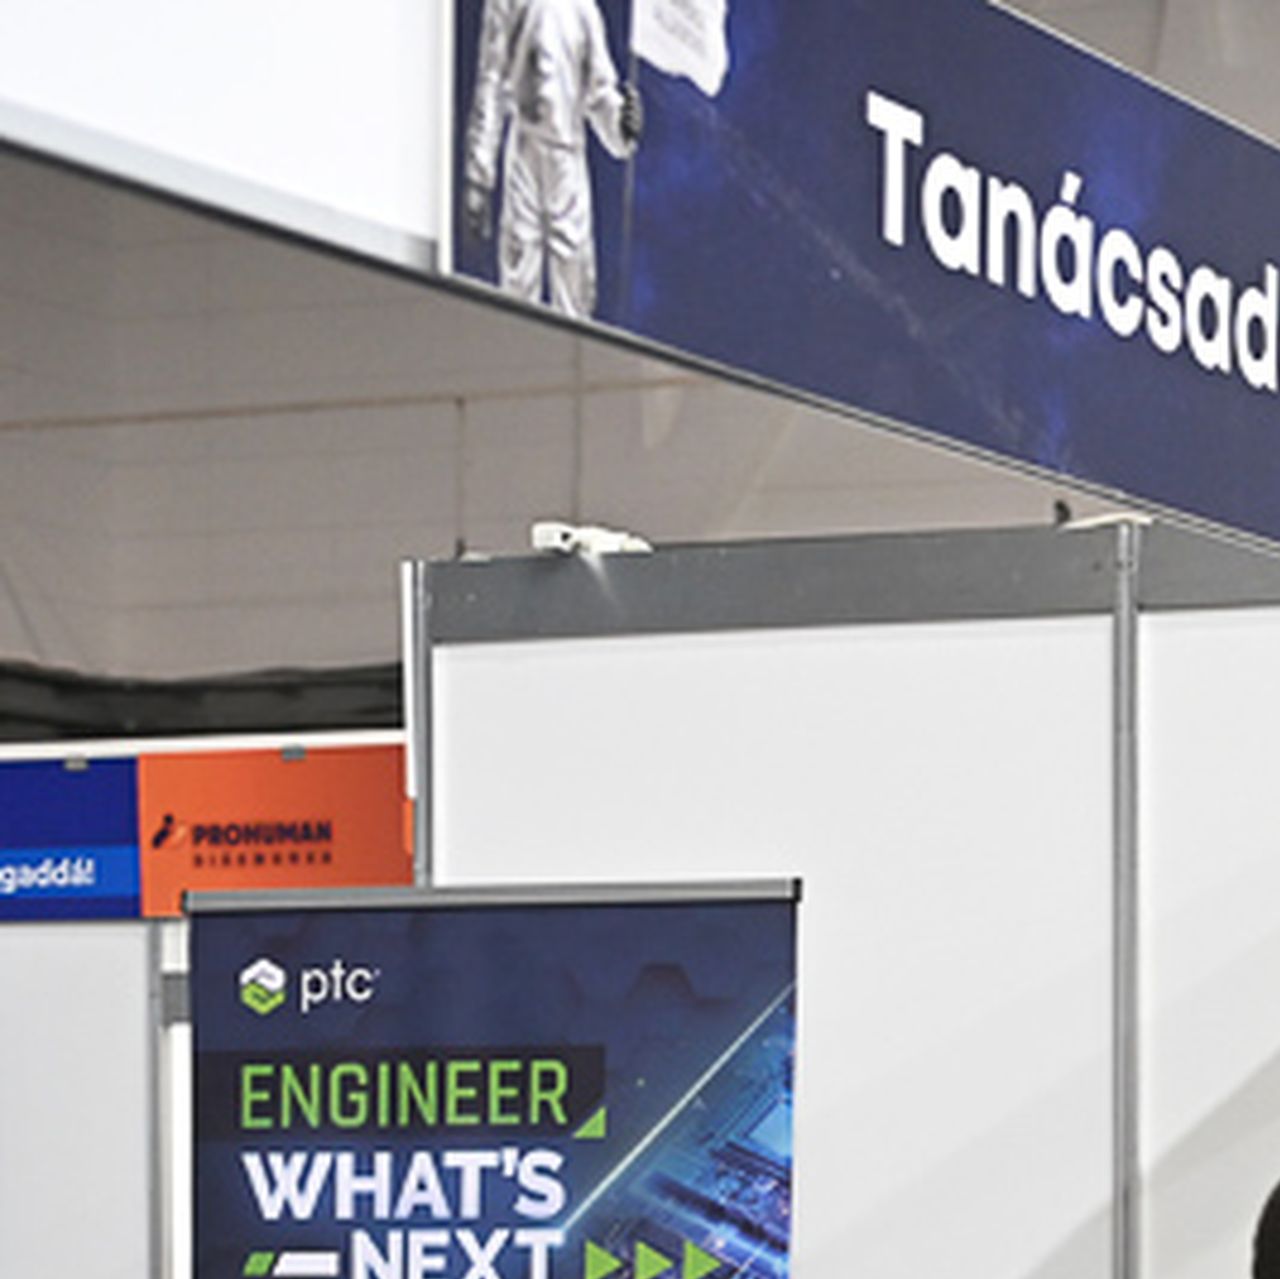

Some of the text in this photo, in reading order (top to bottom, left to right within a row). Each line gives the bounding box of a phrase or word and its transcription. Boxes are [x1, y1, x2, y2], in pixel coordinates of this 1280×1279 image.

[193, 819, 332, 846] PROHUMAN
[301, 959, 374, 1013] ptc
[240, 1060, 568, 1129] ENGINEER
[241, 1148, 566, 1221] WHAT'S
